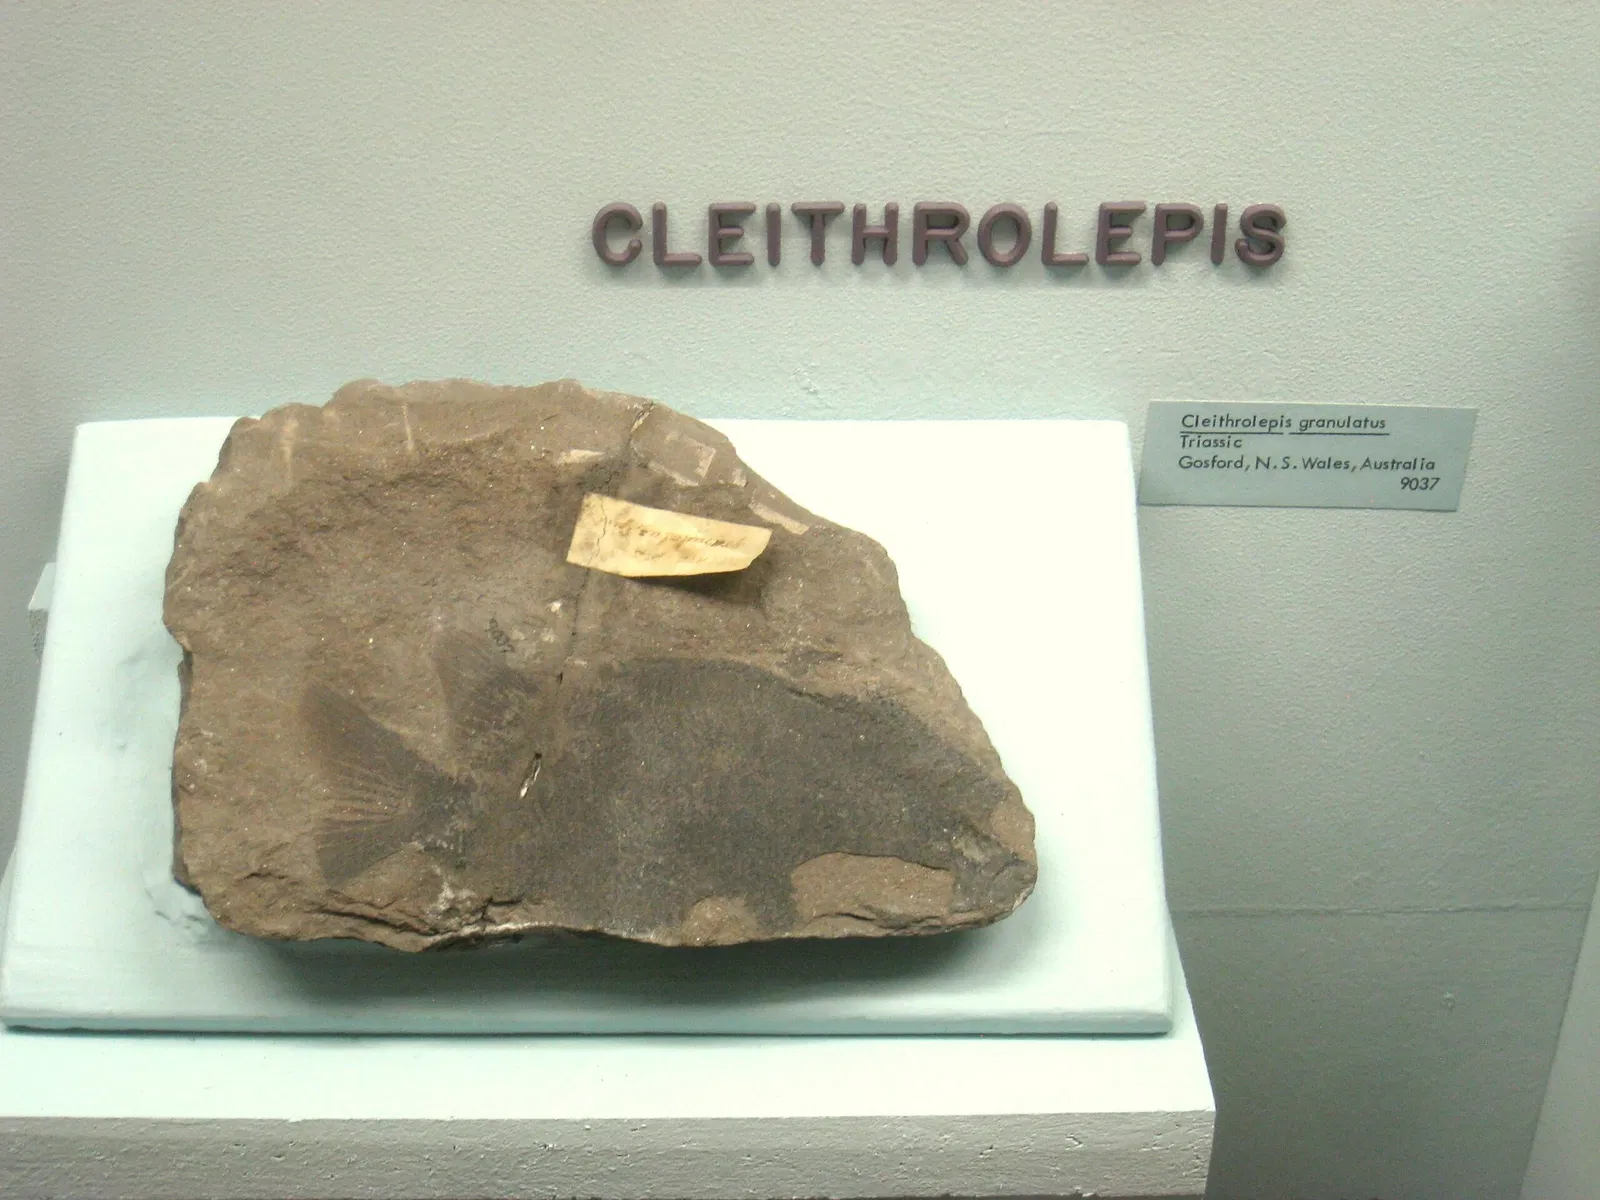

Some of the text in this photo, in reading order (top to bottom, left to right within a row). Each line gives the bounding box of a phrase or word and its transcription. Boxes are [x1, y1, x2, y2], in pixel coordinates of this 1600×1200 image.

[591, 201, 1287, 270] CLEITHROLEPIS
[1181, 413, 1386, 433] Cleithrolepis granulatus
[1180, 434, 1243, 449] Triassic
[1178, 455, 1251, 471] Gosford,
[1360, 457, 1436, 471] Australia
[1400, 476, 1440, 491] 9037
